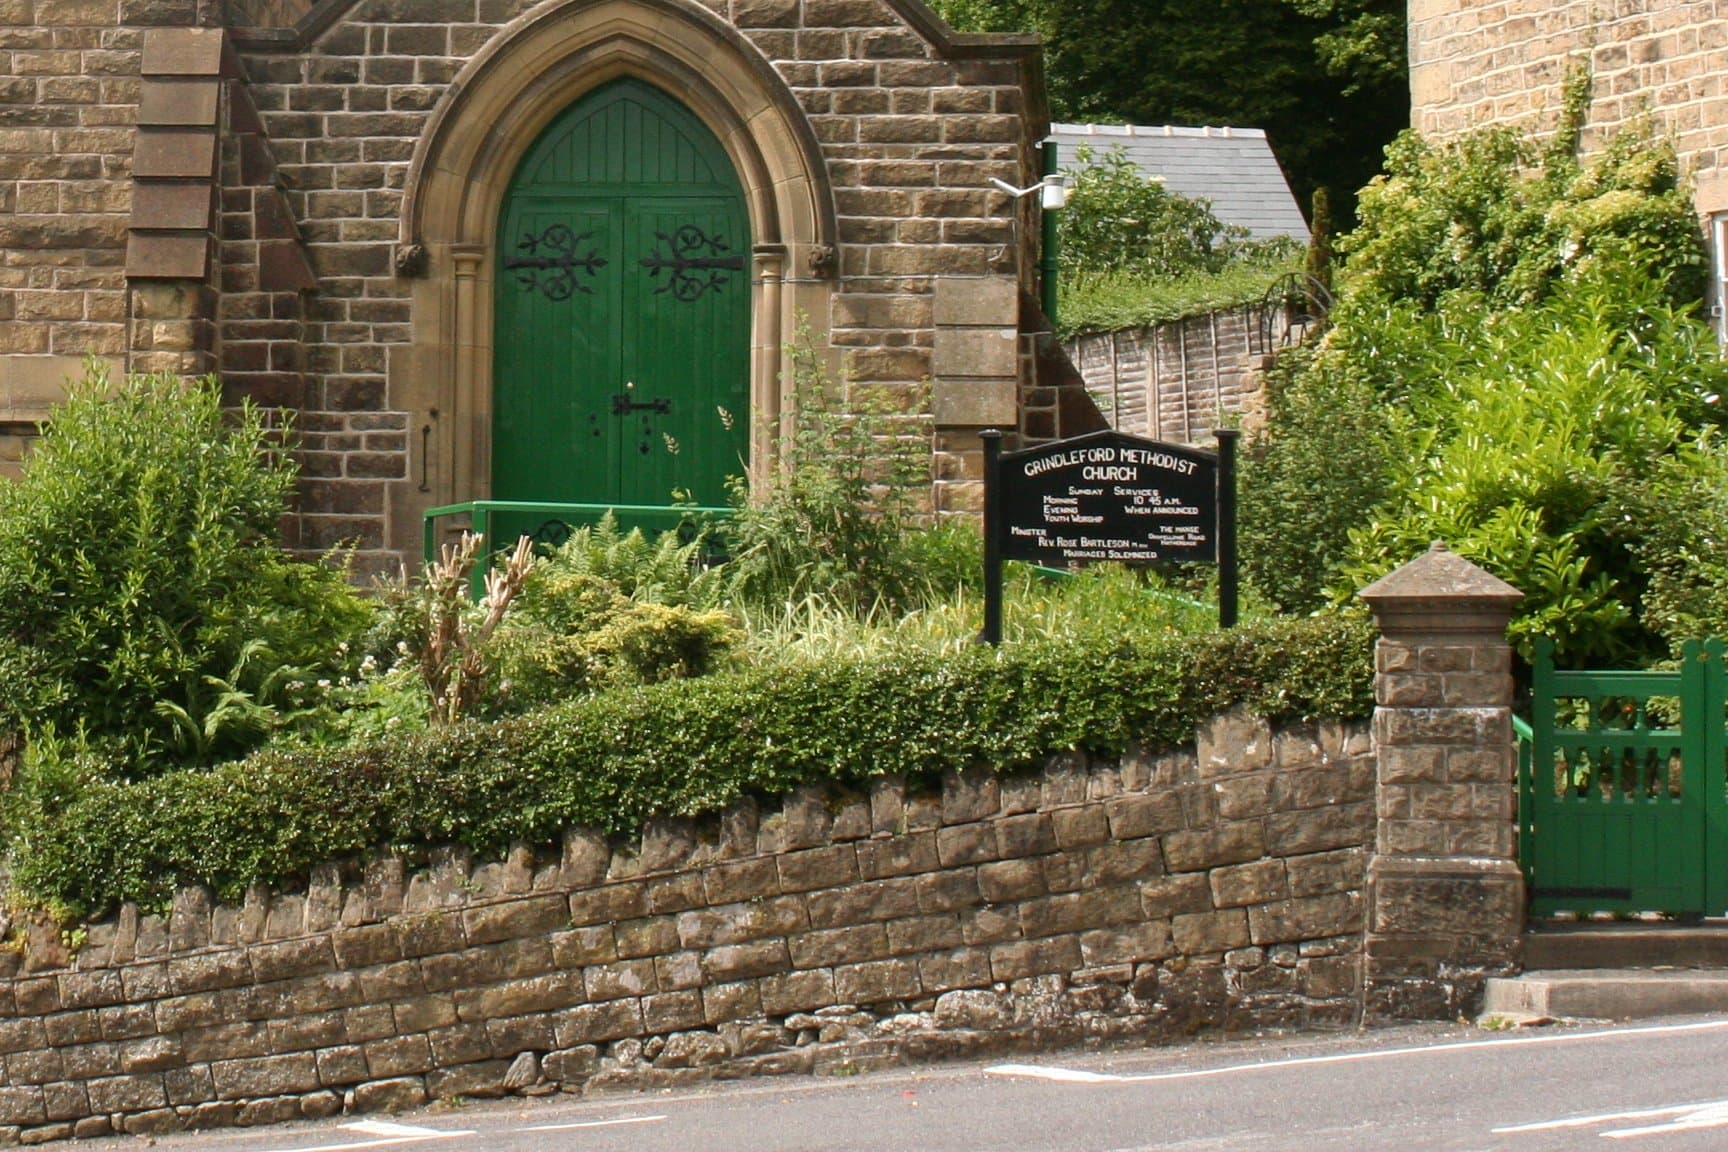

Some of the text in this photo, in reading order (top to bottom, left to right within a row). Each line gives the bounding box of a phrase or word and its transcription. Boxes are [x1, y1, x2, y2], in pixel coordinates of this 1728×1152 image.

[1025, 448, 1197, 476] GRINDLEFORD METHODIST
[1083, 467, 1136, 481] CHURCH
